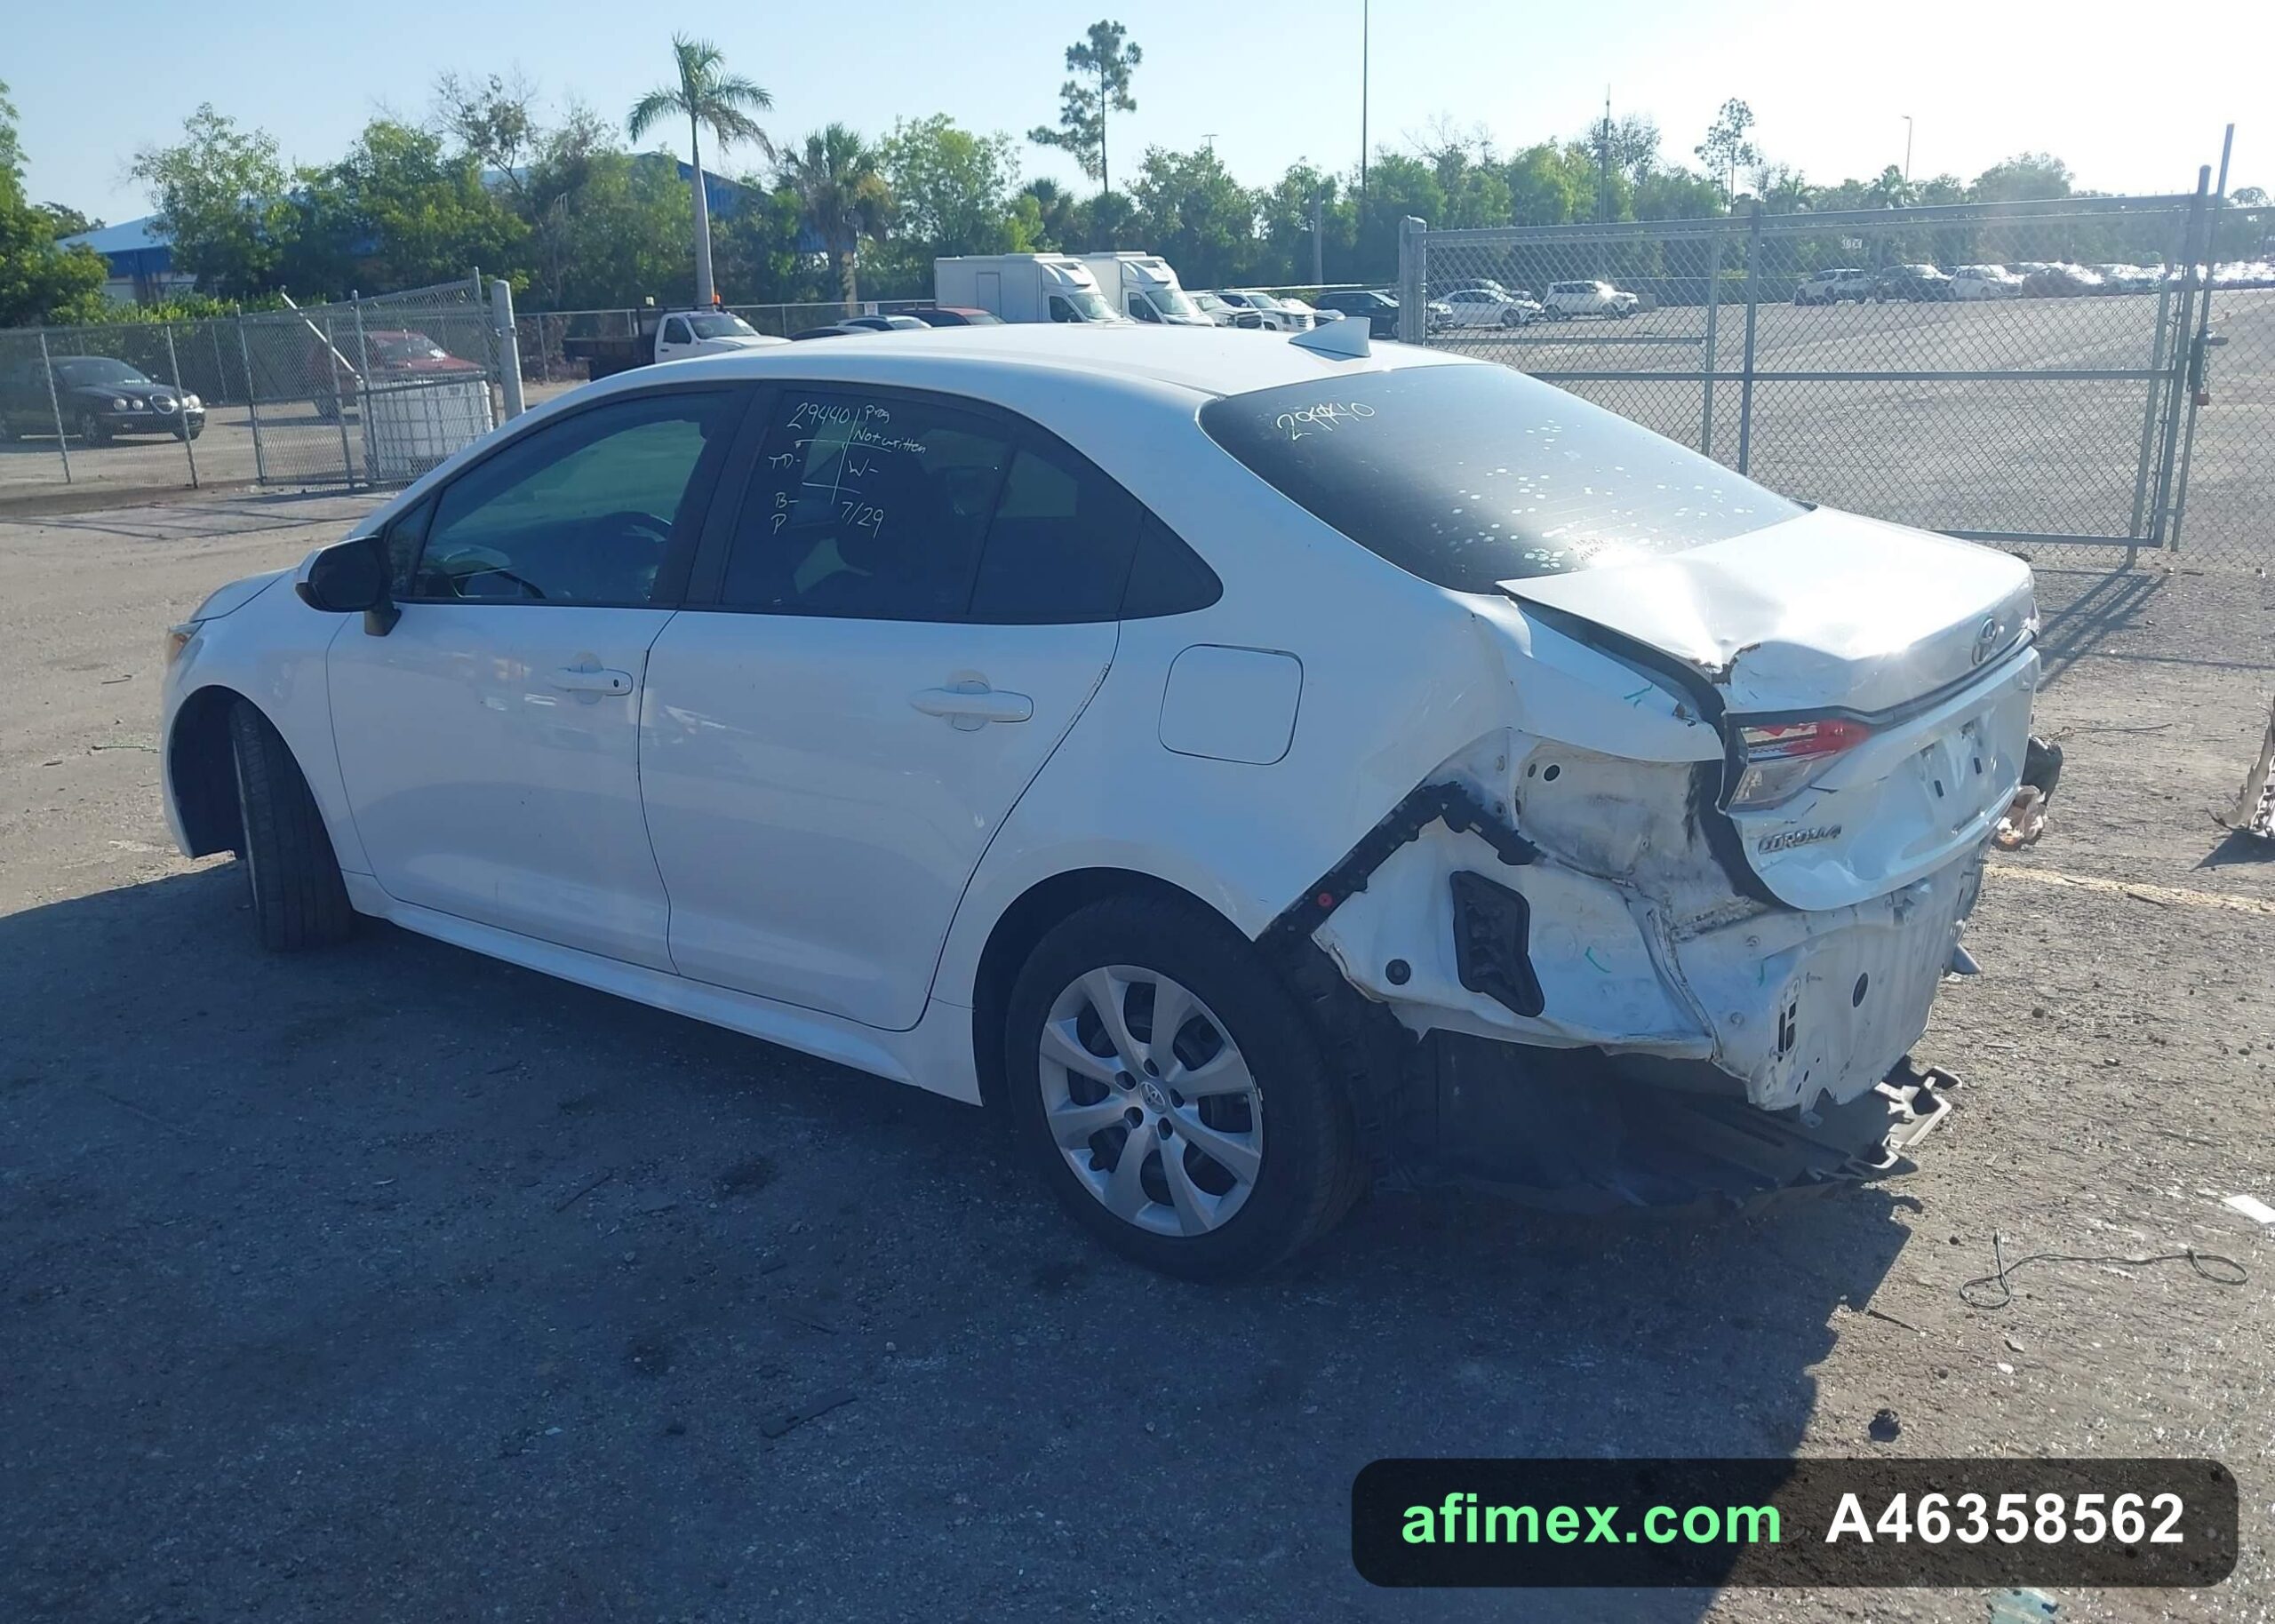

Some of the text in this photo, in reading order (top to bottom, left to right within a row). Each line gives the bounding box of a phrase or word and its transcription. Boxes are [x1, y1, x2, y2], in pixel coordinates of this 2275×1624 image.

[786, 402, 850, 430] 29440
[853, 427, 927, 454] Not written
[770, 513, 787, 535] P
[841, 501, 884, 539] 7/29
